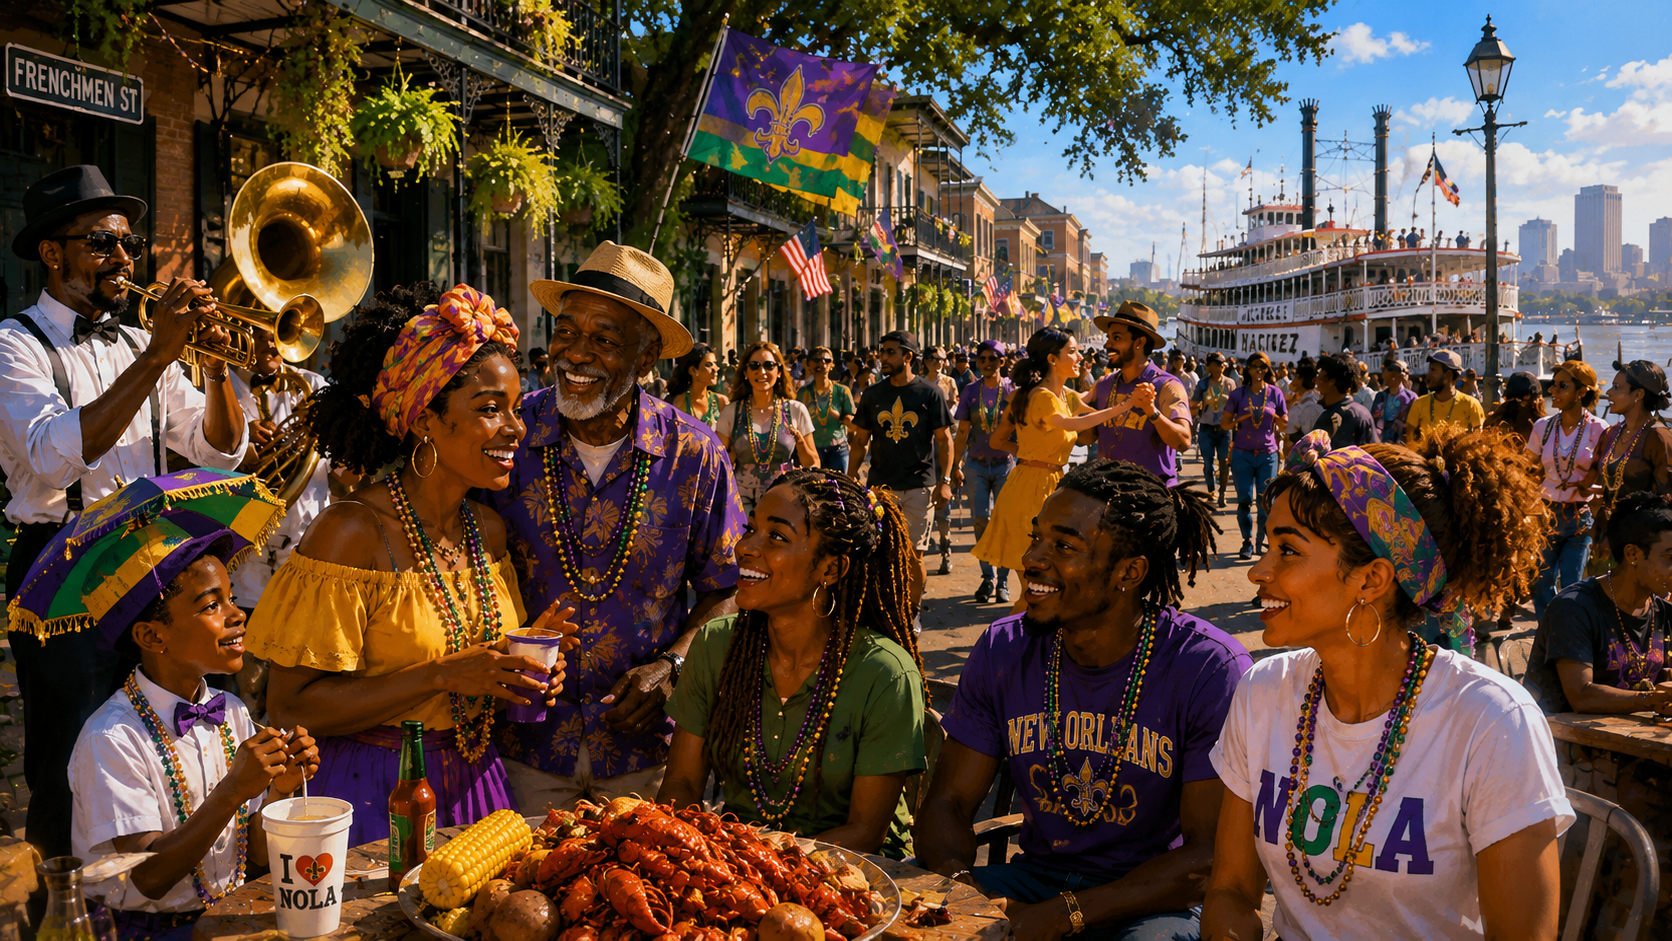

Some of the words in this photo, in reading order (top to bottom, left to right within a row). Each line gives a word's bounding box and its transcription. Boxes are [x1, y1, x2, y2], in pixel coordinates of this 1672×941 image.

[14, 56, 115, 109] FRENCHMEN
[120, 85, 138, 113] ST
[1064, 710, 1173, 778] ORLANS
[1254, 768, 1434, 875] NOLA
[278, 885, 337, 910] NOLA
[280, 853, 294, 885] I
